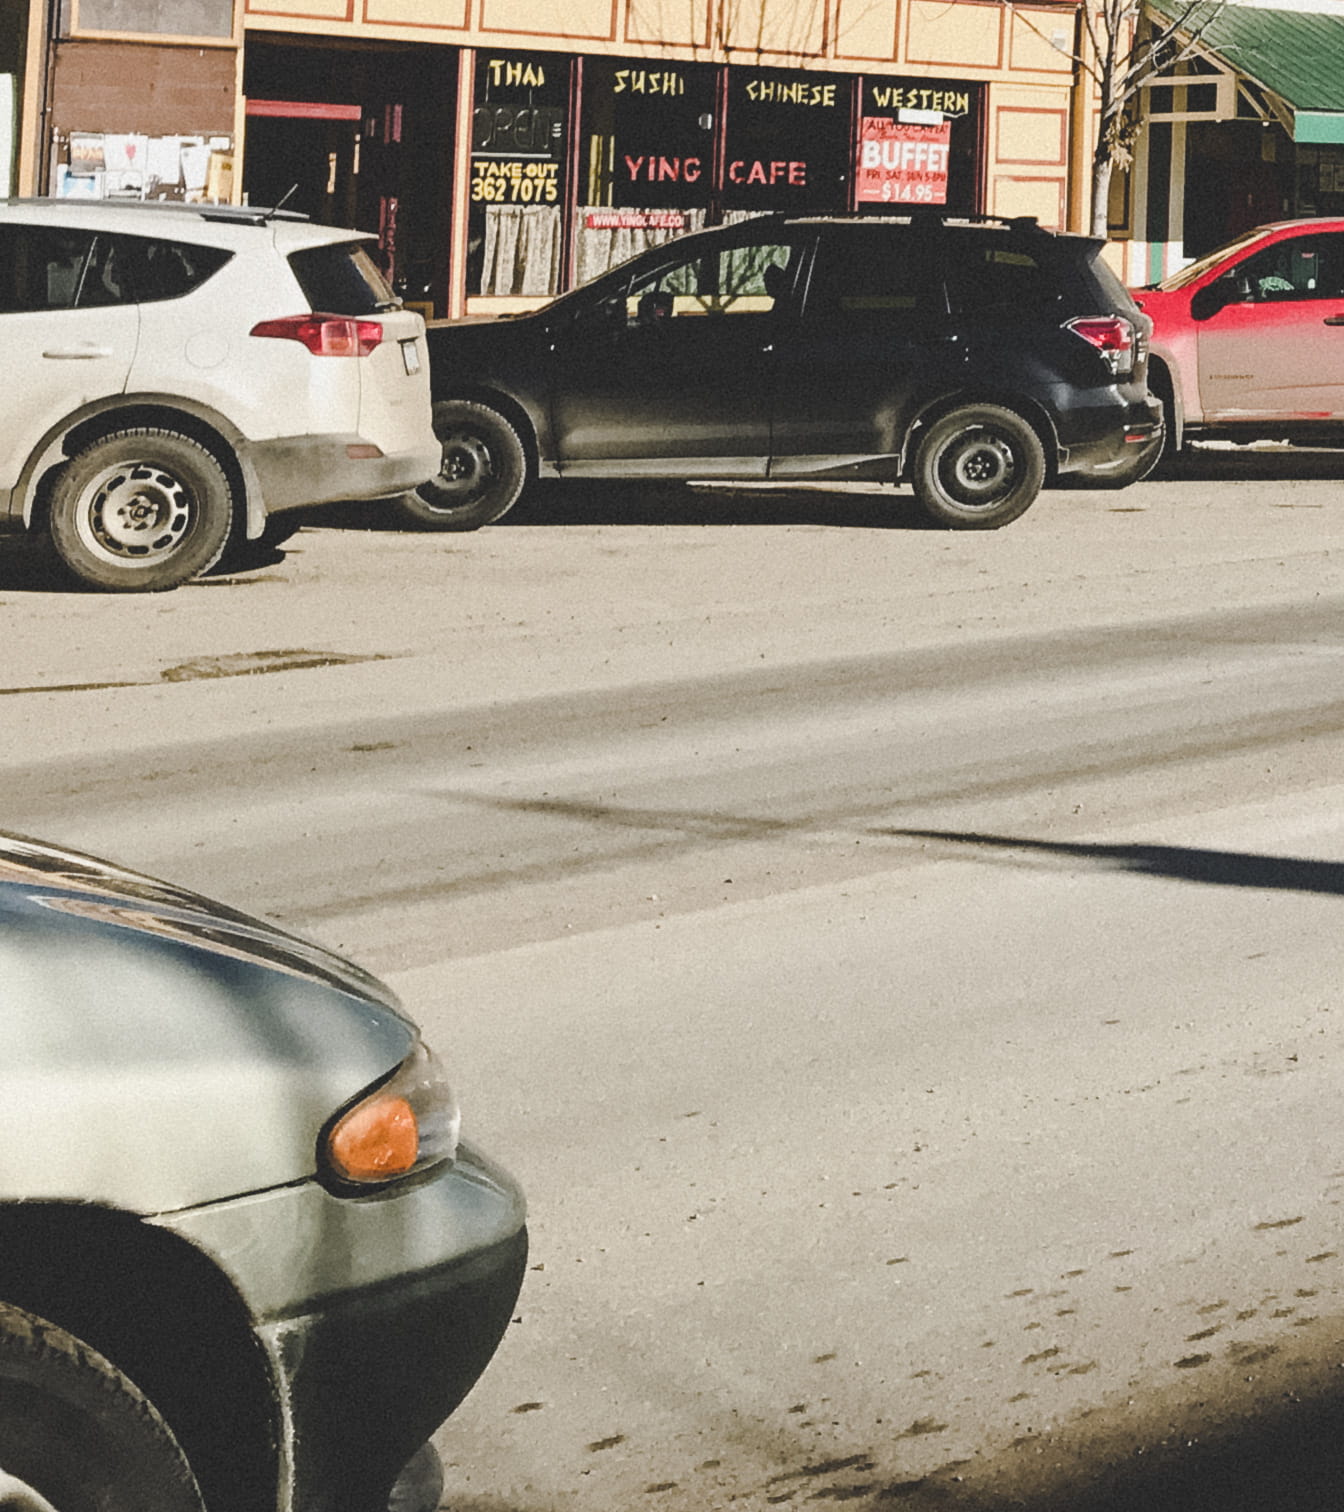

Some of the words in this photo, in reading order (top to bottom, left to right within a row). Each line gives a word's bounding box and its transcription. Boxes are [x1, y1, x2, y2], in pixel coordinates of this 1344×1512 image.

[489, 60, 545, 87] THAI
[613, 69, 685, 96] SUSHI
[746, 80, 837, 107] CHINESE
[872, 86, 969, 115] WESTERN
[862, 139, 951, 173] BUFFET
[473, 161, 559, 179] TAKE-OUT
[624, 155, 702, 183] YING
[729, 160, 807, 186] CAFE
[471, 178, 507, 202] 362
[509, 178, 558, 202] 7075
